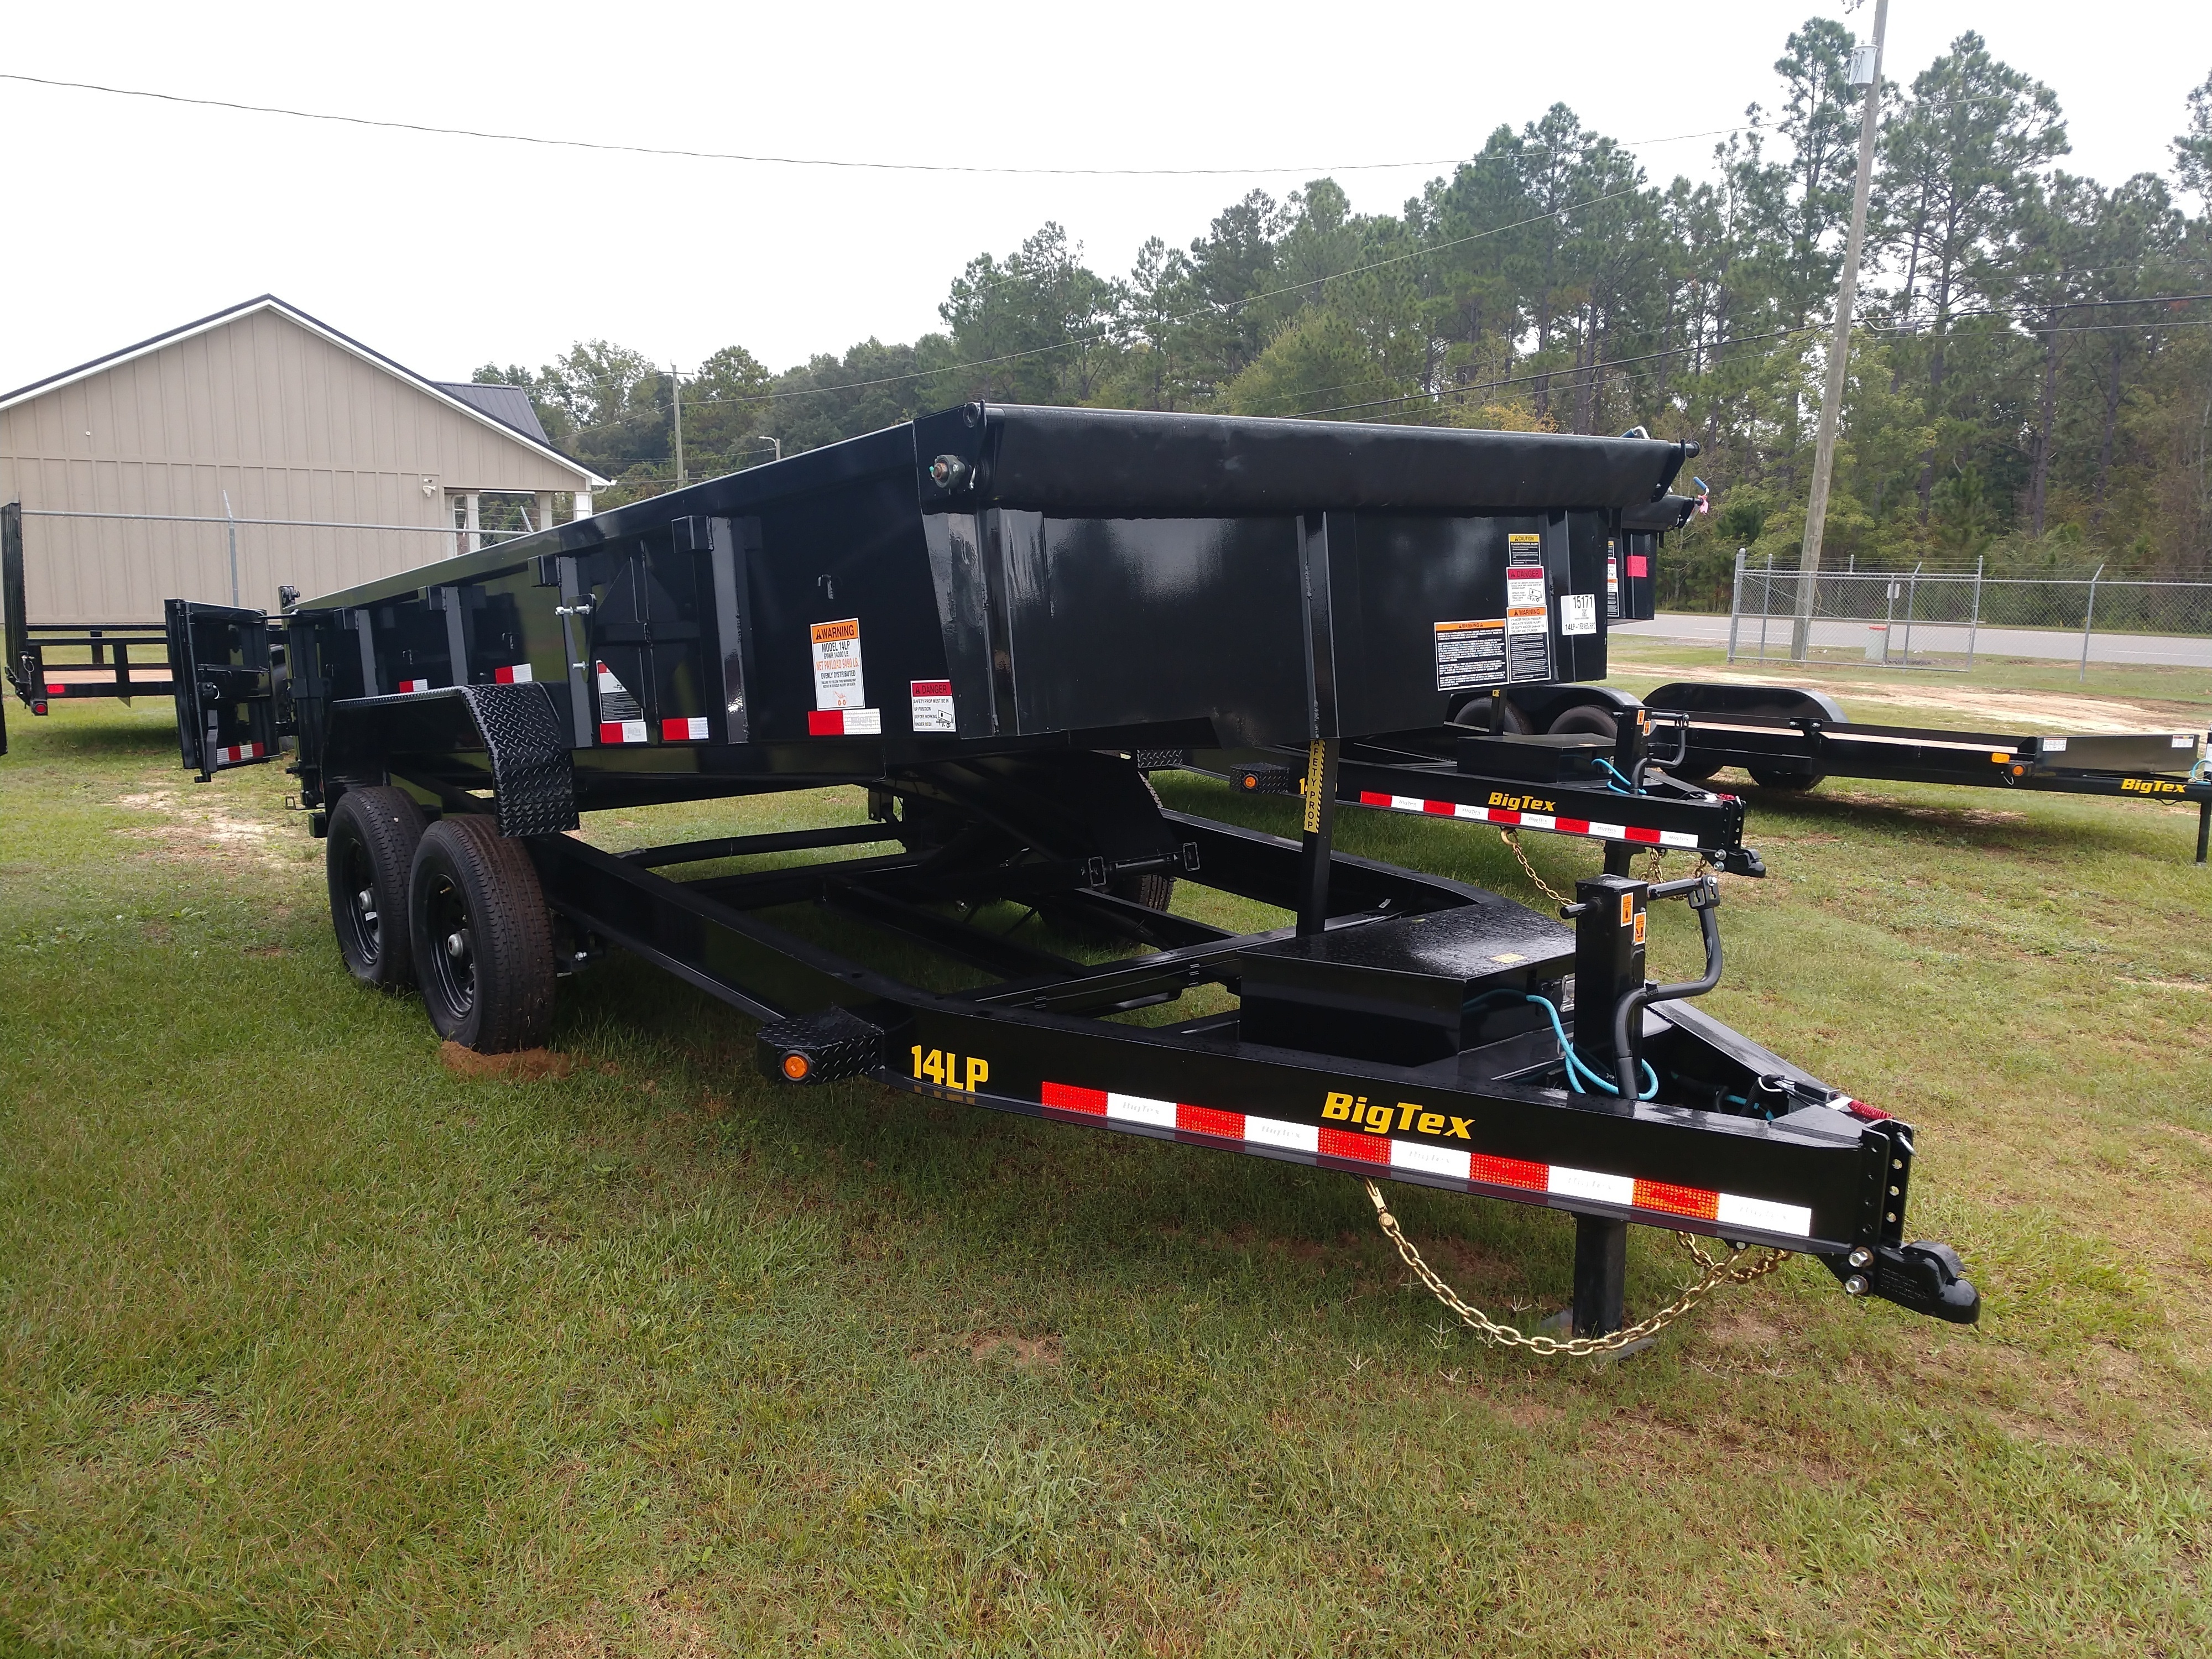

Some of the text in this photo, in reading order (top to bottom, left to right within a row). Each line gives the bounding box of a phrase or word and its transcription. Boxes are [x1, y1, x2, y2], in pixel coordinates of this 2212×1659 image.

[1573, 596, 1593, 608] 15171
[821, 624, 854, 640] WARNING
[822, 640, 850, 653] MODEL 14LP
[824, 659, 841, 670] PAYLOAD
[842, 658, 852, 669] 9490
[834, 670, 855, 678] DISTRIBUTED
[922, 685, 947, 693] DANGER
[1307, 739, 1320, 829] AFETY PROP
[2121, 779, 2188, 794] BigTex
[1488, 792, 1556, 812] BigTex
[911, 1045, 989, 1092] 14LP
[1321, 1092, 1475, 1140] BigTex
